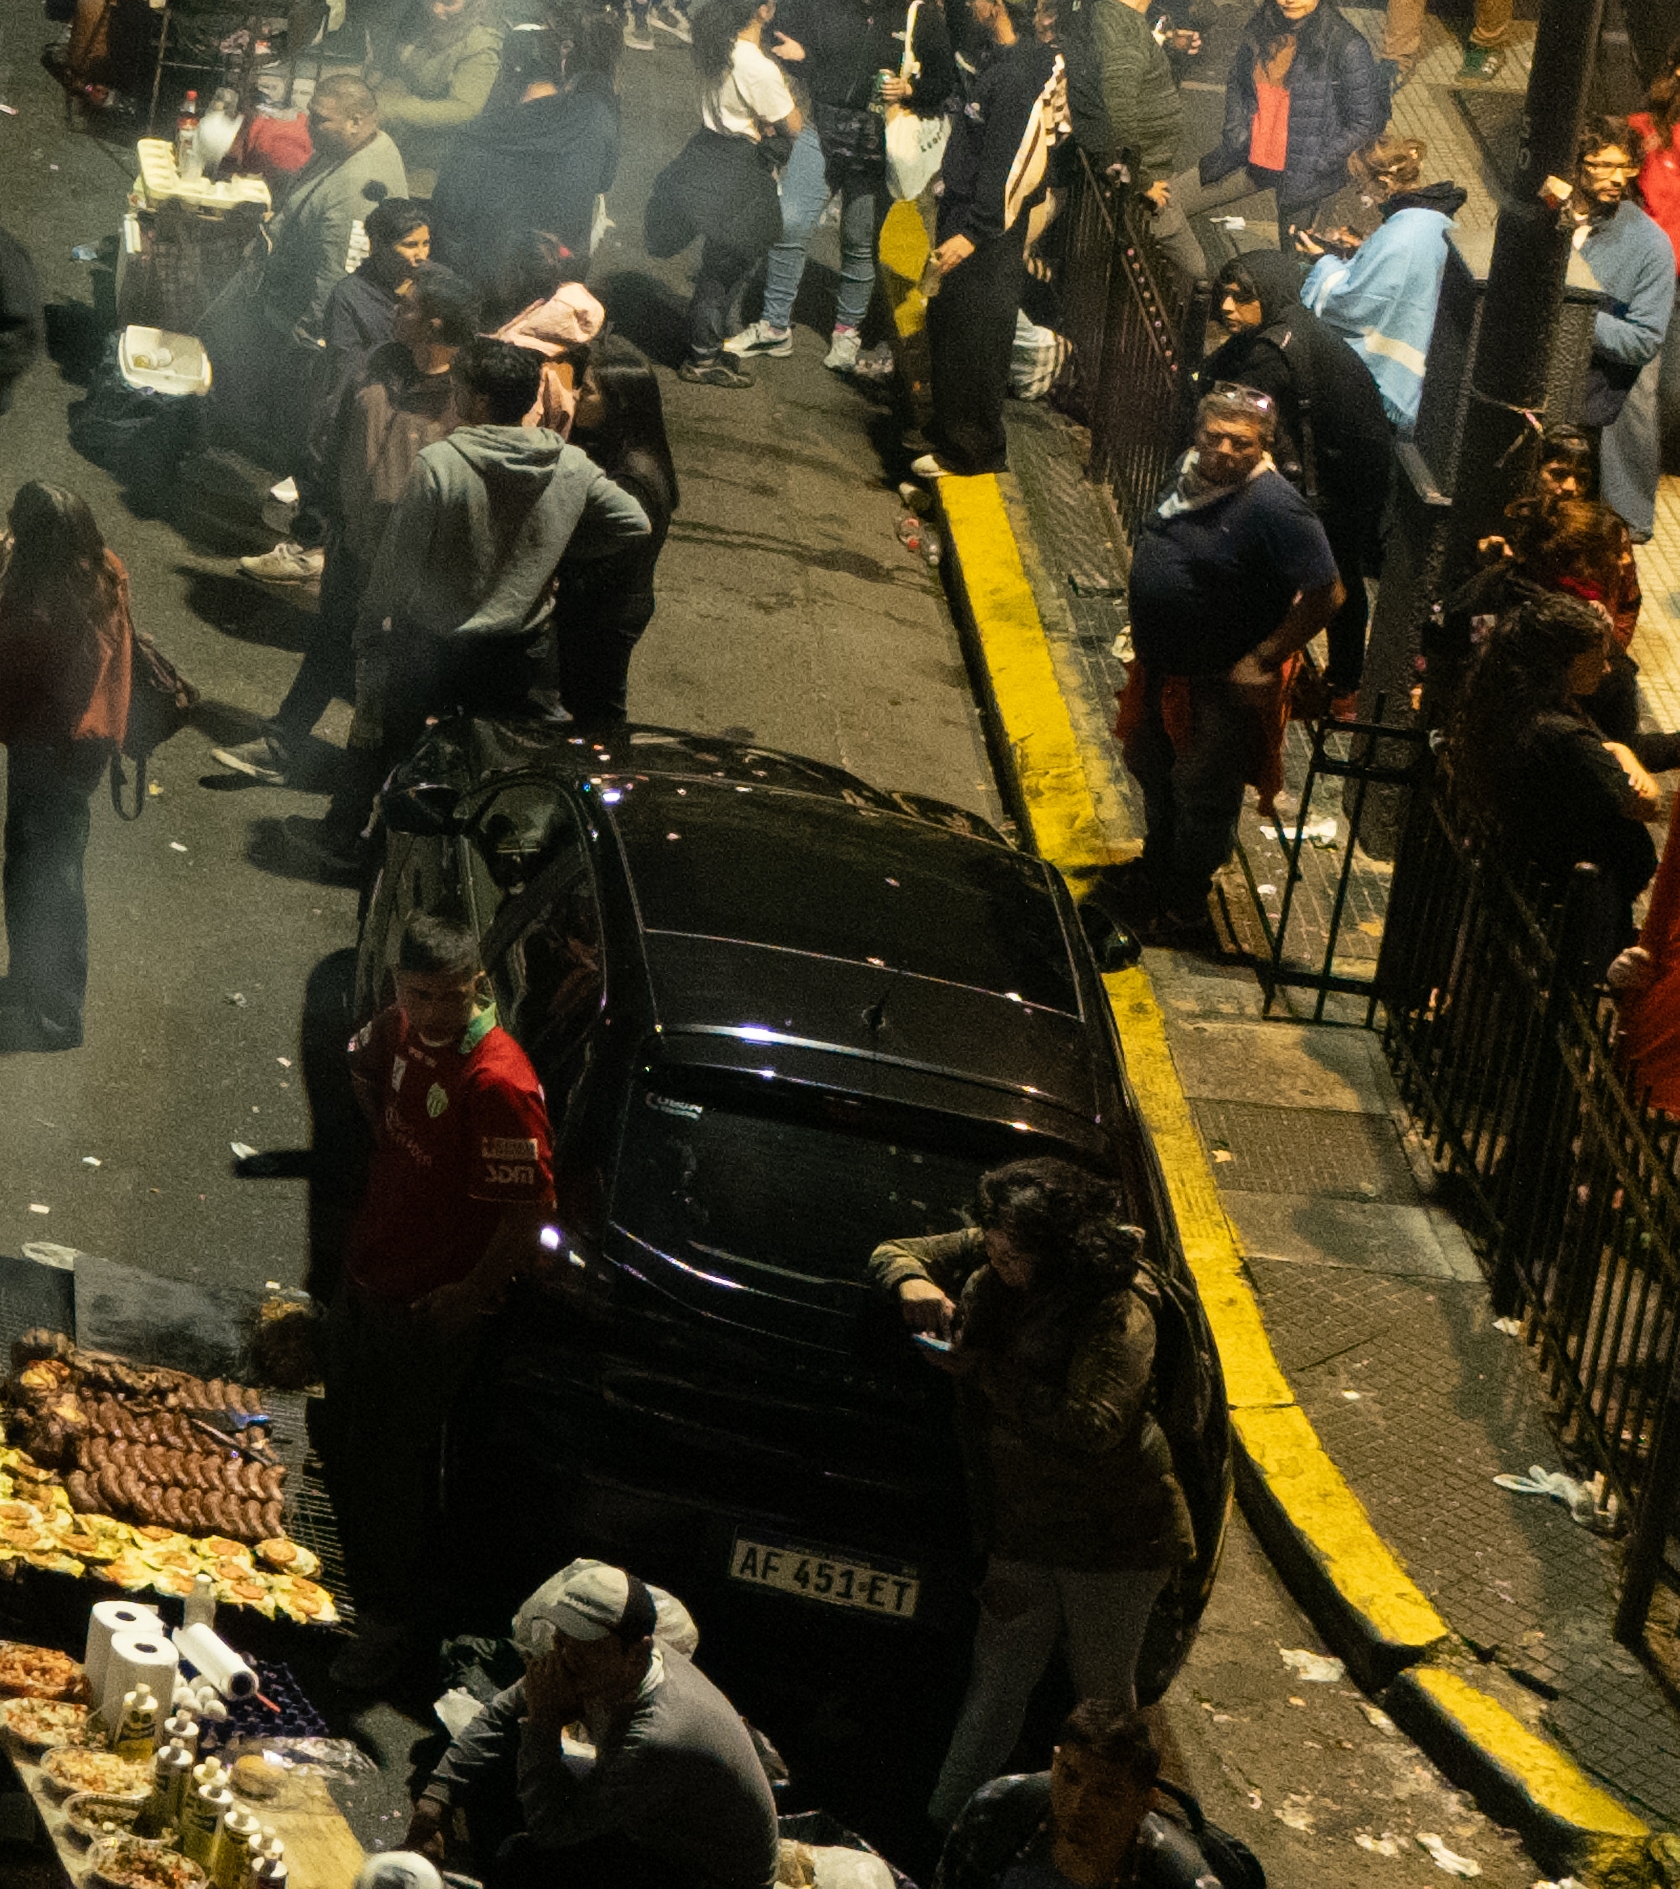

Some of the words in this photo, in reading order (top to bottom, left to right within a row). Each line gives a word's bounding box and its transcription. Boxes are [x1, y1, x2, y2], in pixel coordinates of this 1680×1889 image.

[739, 1546, 783, 1580] AF
[793, 1558, 855, 1599] 451
[866, 1574, 911, 1611] ET
